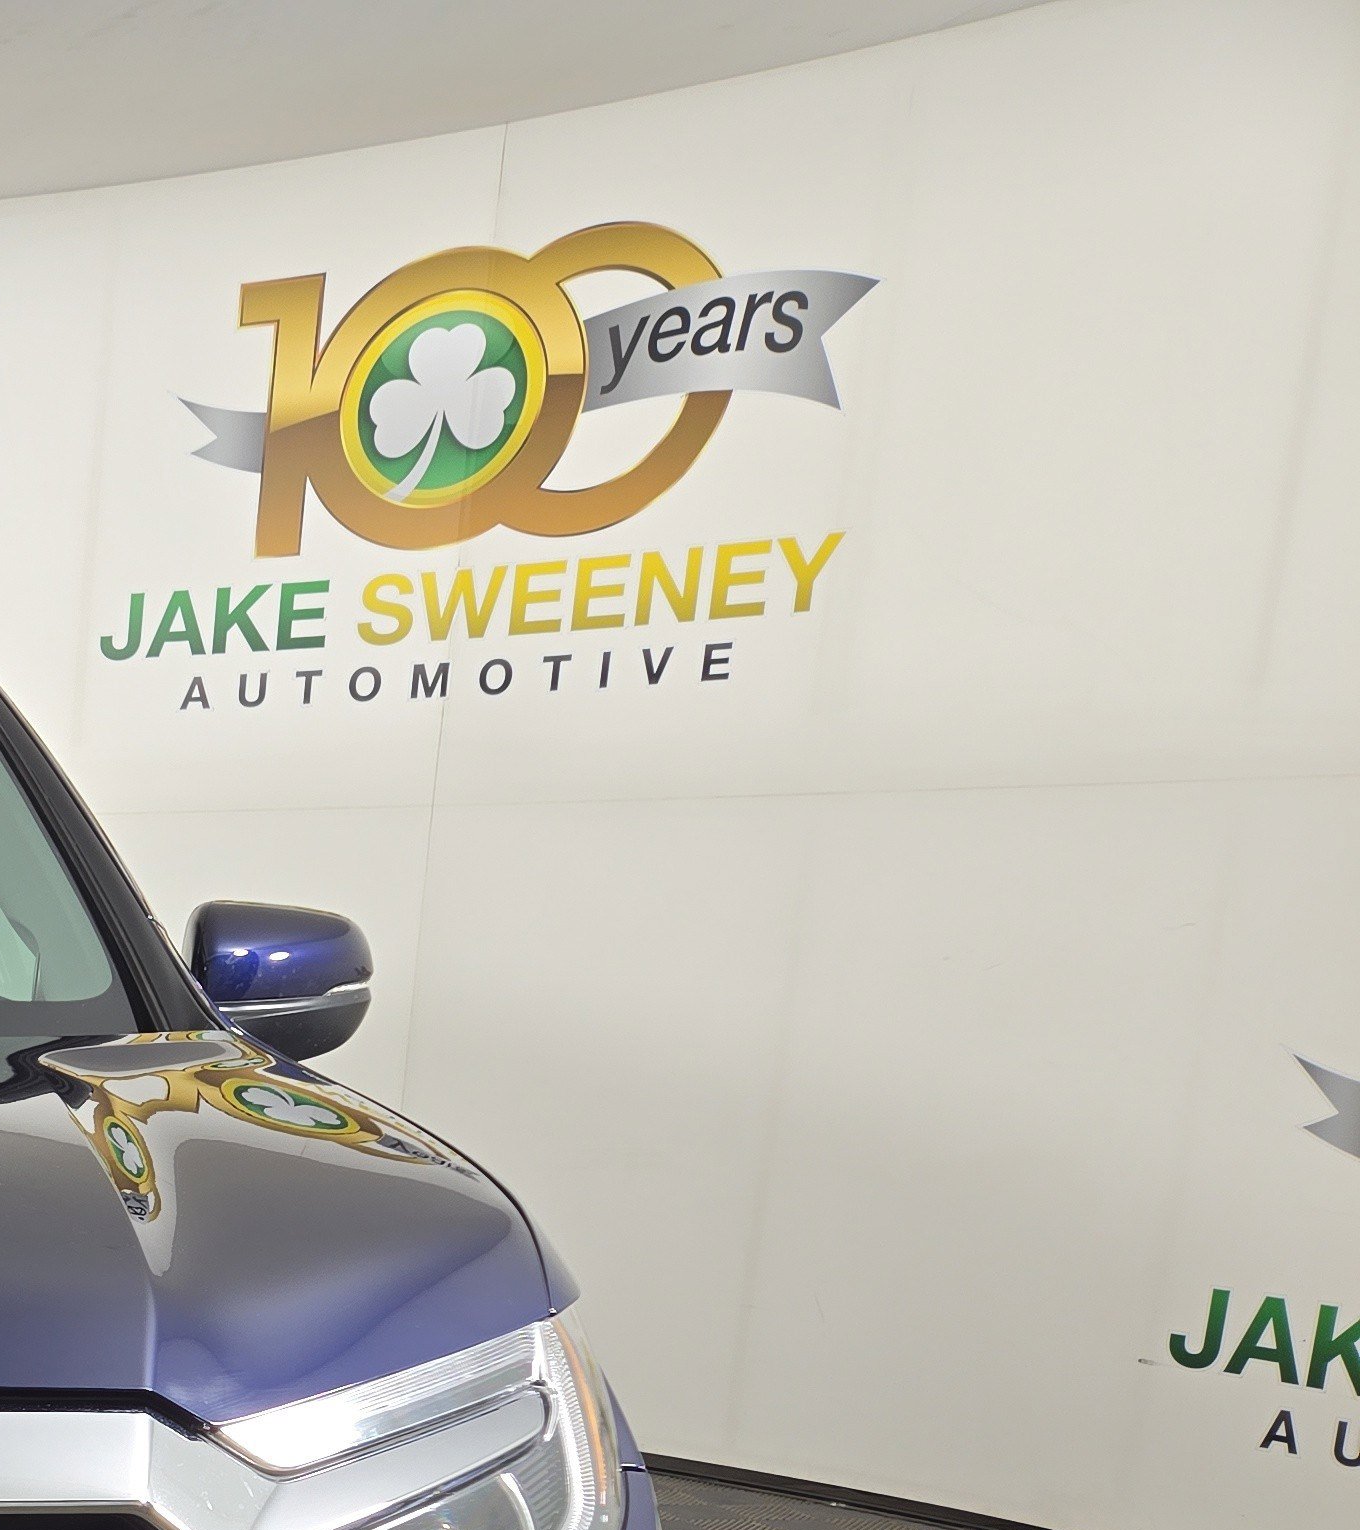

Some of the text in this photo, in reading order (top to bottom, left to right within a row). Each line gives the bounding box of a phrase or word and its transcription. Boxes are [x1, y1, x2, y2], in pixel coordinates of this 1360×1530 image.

[237, 220, 809, 558] 100 years
[100, 531, 846, 661] JAKE SWEENEY
[179, 642, 733, 710] AUTOMOTIVE
